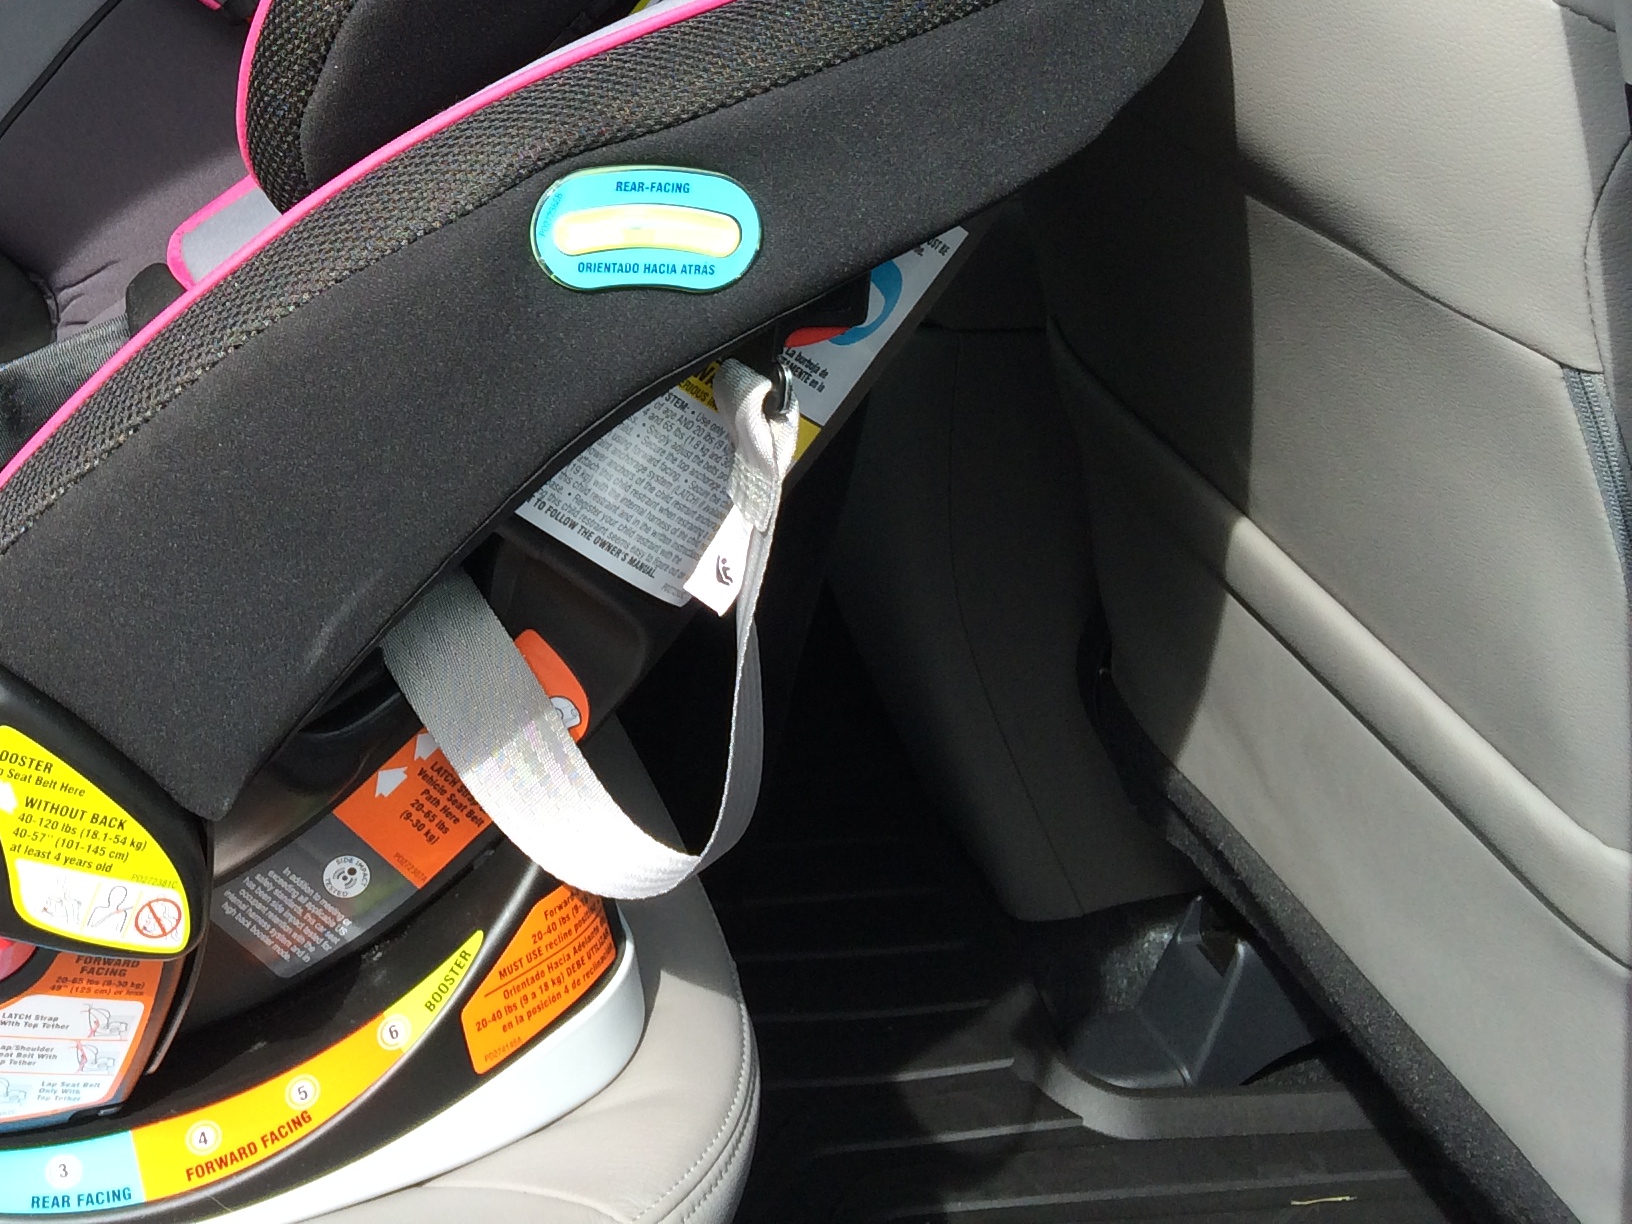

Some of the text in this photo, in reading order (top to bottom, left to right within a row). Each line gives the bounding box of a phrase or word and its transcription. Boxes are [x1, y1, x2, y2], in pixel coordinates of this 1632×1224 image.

[615, 181, 690, 194] REAR-FACING
[577, 261, 716, 275] ORIENTADO HACIA ATRÁS
[532, 497, 546, 510] TO
[544, 504, 578, 530] FOLLOW
[576, 524, 594, 541] THE
[592, 535, 629, 561] OWNER'S
[6, 767, 32, 783] Seat
[34, 775, 57, 789] Belt
[59, 781, 85, 797] Here
[429, 760, 460, 787] LATCH
[416, 766, 484, 827] Vehicle Seat Belt
[419, 788, 460, 824] Path Here
[24, 795, 127, 831] WITHOUT BACK
[399, 809, 439, 845] (9-30 kg)
[409, 798, 449, 834] 20-65 lbs
[17, 812, 147, 851] 40-120 lbs (18.1-54 kg)
[9, 843, 113, 873] at least 4 years old
[54, 837, 106, 856] (101-145
[108, 850, 129, 863] cm)
[531, 913, 570, 944] 20-40 lbs
[499, 928, 572, 980] MUST USE recline
[79, 962, 127, 977] FACING
[425, 949, 471, 1011] BOOSTER
[502, 971, 545, 999] Orientado
[546, 953, 571, 973] Hacia
[475, 955, 585, 1032] 20-40 lbs (9 a 18 kg) DEBE
[502, 977, 581, 1032] en la posición 4 de
[1, 1012, 58, 1024] LATCH Strap
[23, 1021, 38, 1029] Top
[388, 1024, 398, 1039] 6
[9, 1058, 36, 1066] Tether
[15, 1051, 34, 1059] Belt
[297, 1085, 308, 1100] 5
[185, 1110, 317, 1181] FORWARD FACING
[198, 1131, 207, 1144] 4
[58, 1163, 68, 1177] 3
[31, 1187, 131, 1208] REAR FACING
